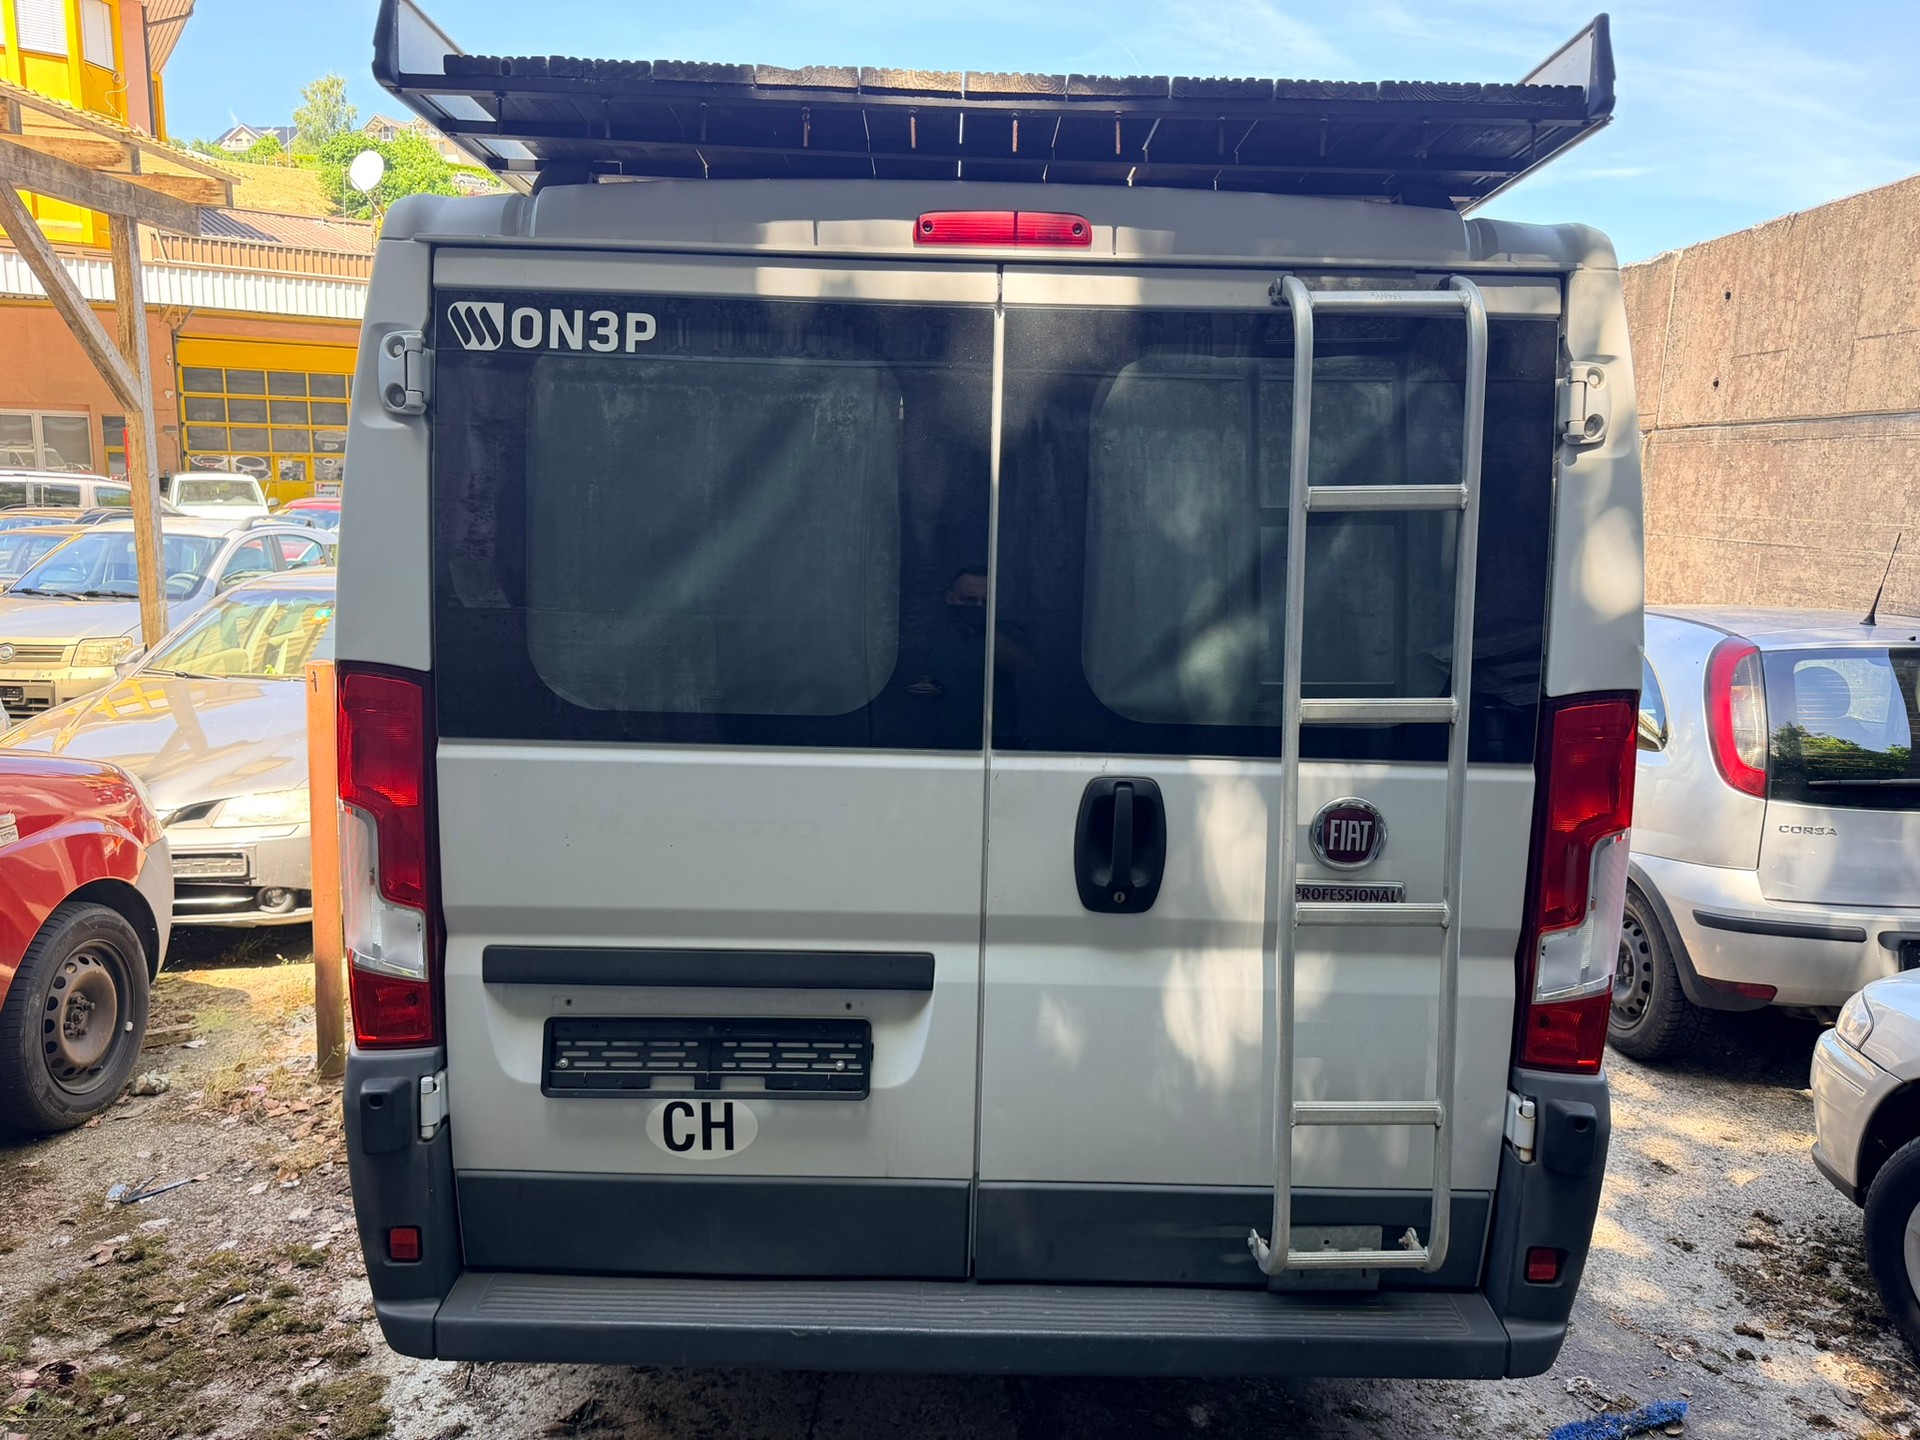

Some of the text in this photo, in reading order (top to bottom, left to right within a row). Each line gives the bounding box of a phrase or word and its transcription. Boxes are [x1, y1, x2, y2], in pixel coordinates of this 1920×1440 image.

[510, 306, 657, 354] ON3P
[1328, 819, 1373, 852] FIAT
[1778, 824, 1838, 836] CORSA
[662, 1100, 735, 1152] CH
